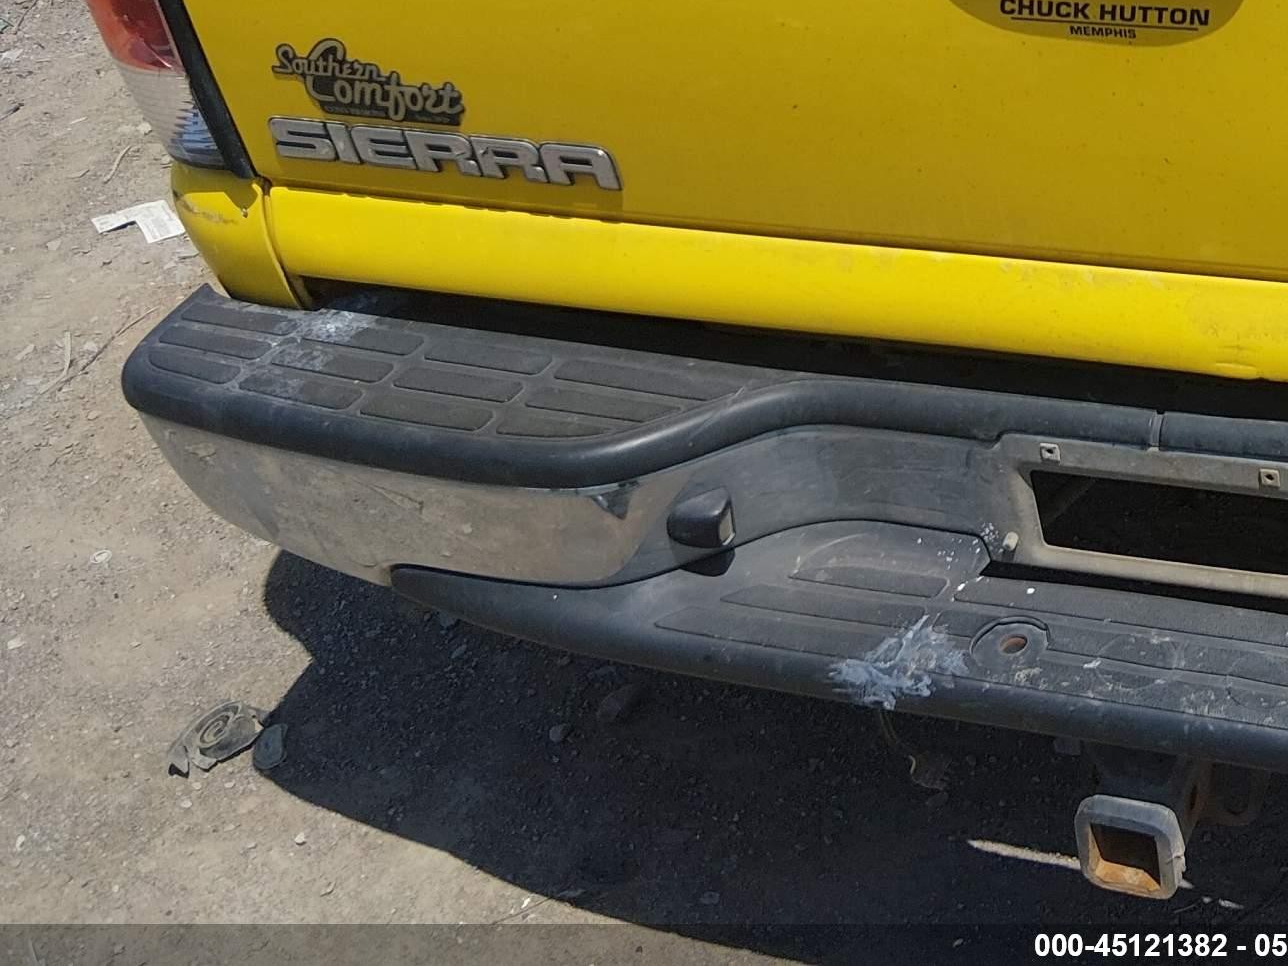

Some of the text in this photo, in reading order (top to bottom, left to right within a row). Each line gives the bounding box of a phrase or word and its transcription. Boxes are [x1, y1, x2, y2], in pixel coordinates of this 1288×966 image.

[1069, 25, 1137, 39] MEMPHIS
[1099, 4, 1210, 26] HUTTON
[272, 43, 387, 82] Southern
[304, 37, 465, 122] Comfort
[268, 116, 622, 191] SIERRA
